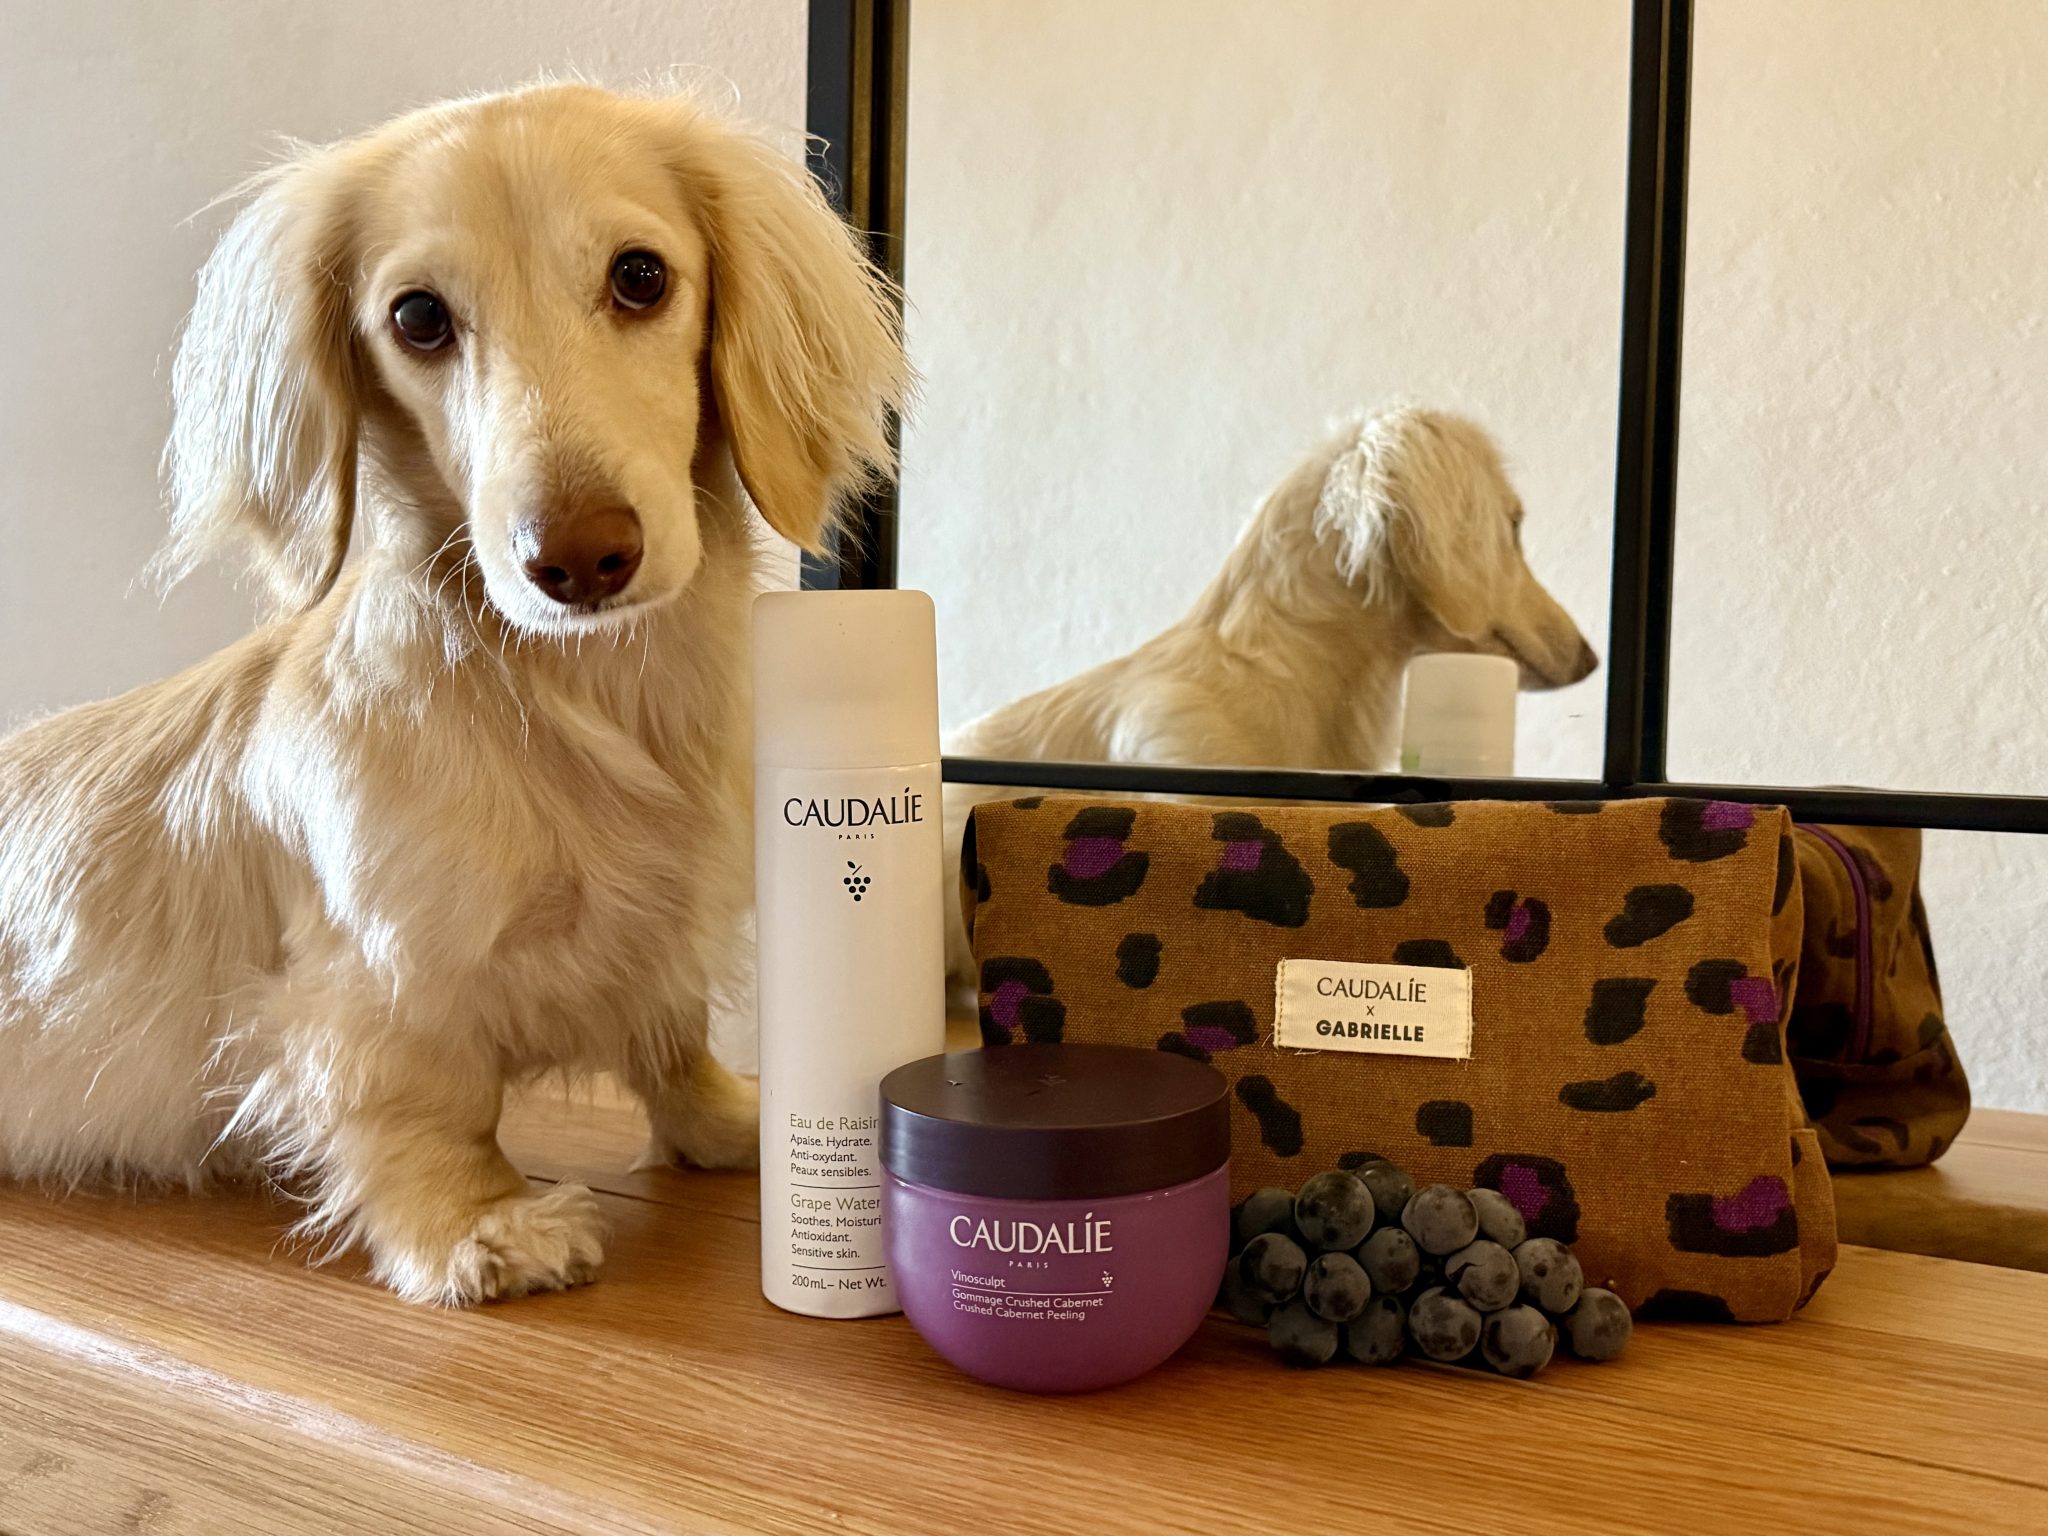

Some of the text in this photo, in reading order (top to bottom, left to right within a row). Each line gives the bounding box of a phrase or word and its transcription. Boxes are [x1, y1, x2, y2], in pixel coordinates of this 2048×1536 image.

[1316, 1019, 1424, 1042] GABRIELLE
[790, 1114, 812, 1129] Eau
[816, 1117, 834, 1131] de
[790, 1134, 872, 1151] Apaise. Hydrate.
[790, 1149, 857, 1163] Anti-oxydant.
[790, 1163, 872, 1177] Peaux sensibles.
[791, 1194, 832, 1212] Grape
[791, 1213, 833, 1228] Soothes.
[791, 1229, 852, 1243] Antioxidant.
[791, 1244, 860, 1259] Sensitive skin.
[1009, 1261, 1048, 1269] PARIS
[838, 1278, 862, 1290] Net
[865, 1276, 887, 1288] Wt.
[951, 1269, 1006, 1288] Vinosculpt
[952, 1288, 1103, 1308] Gommage Crushed Cabernet
[953, 1300, 1085, 1321] Crushed Cabernet Peeling
